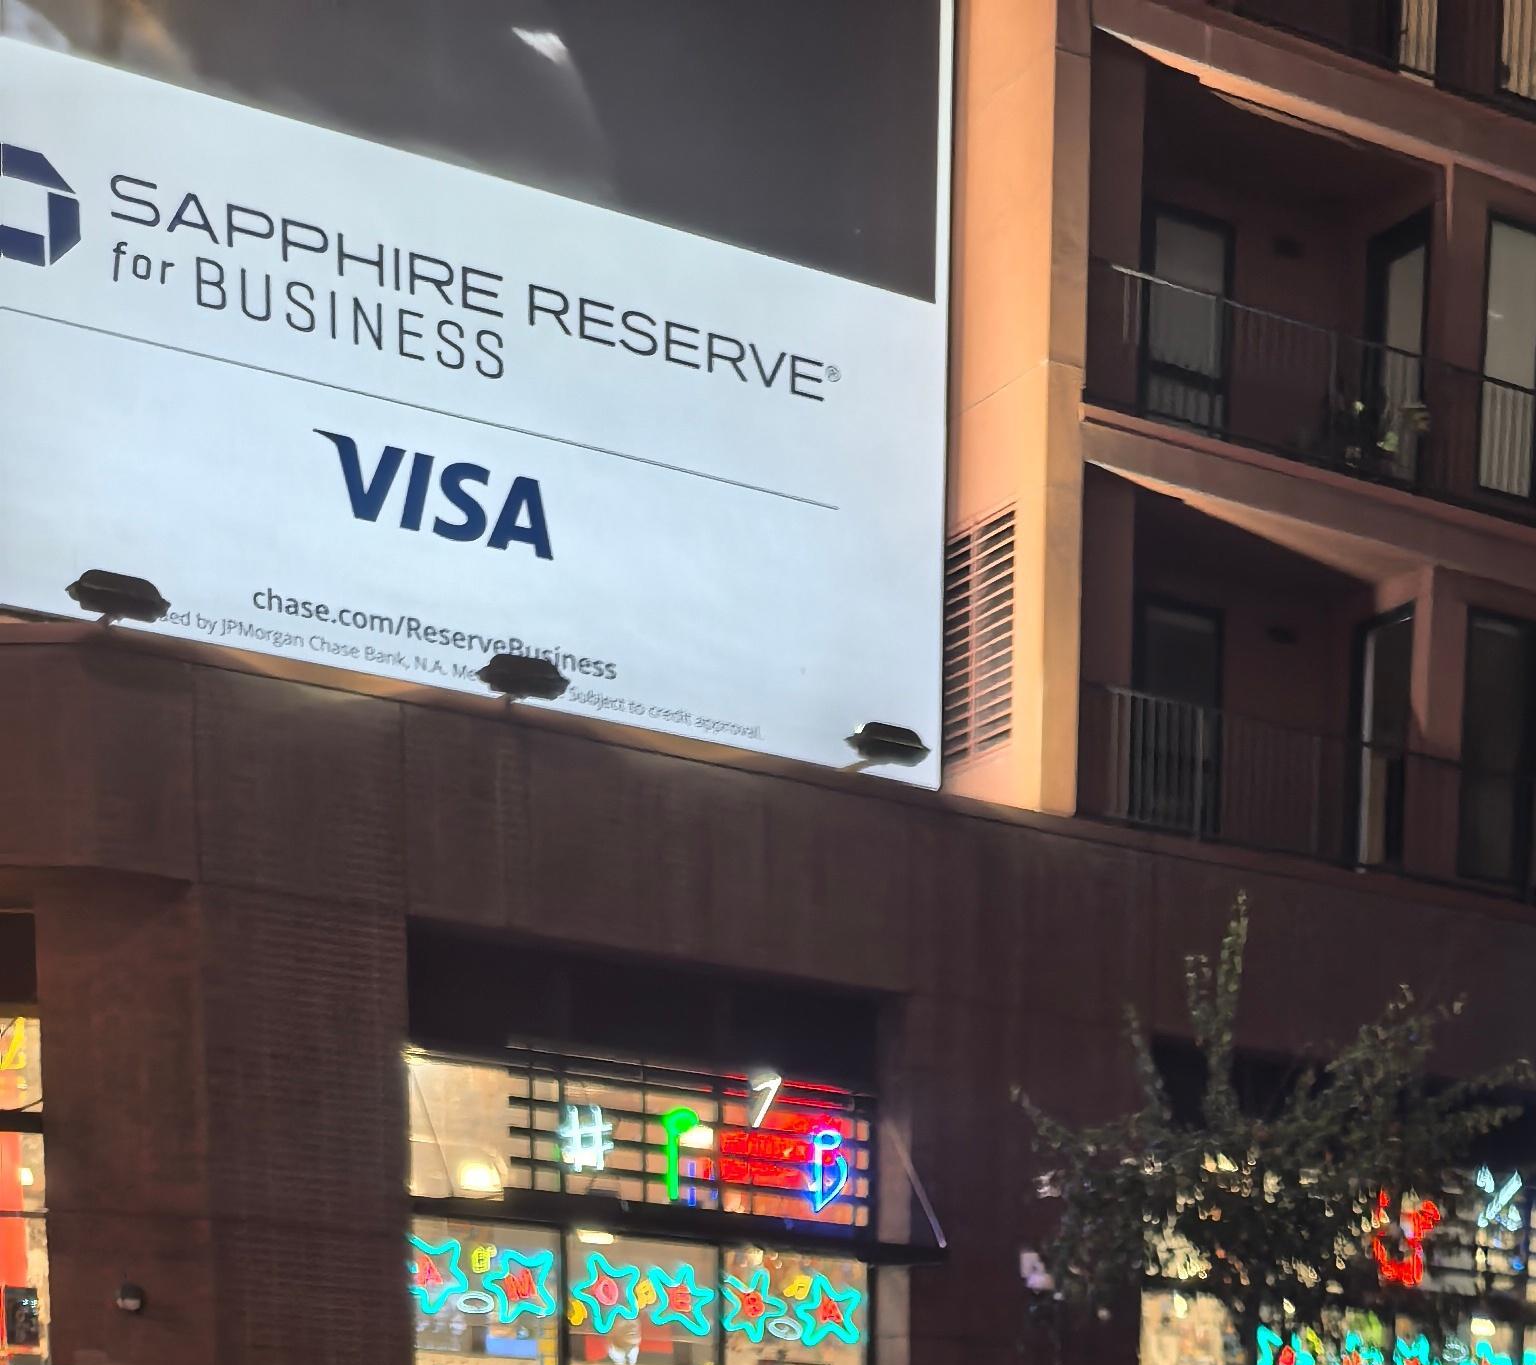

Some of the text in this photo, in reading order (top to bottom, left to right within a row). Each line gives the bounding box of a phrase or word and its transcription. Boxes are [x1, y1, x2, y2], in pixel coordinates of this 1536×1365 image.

[110, 174, 504, 319] SAPPHIRE
[112, 241, 505, 380] for BUSINESS
[312, 428, 554, 561] VISA
[196, 611, 218, 636] by
[219, 617, 304, 648] JPMorgan
[308, 634, 361, 659] Chase
[252, 587, 618, 681] chase.com/ReserveBusiness
